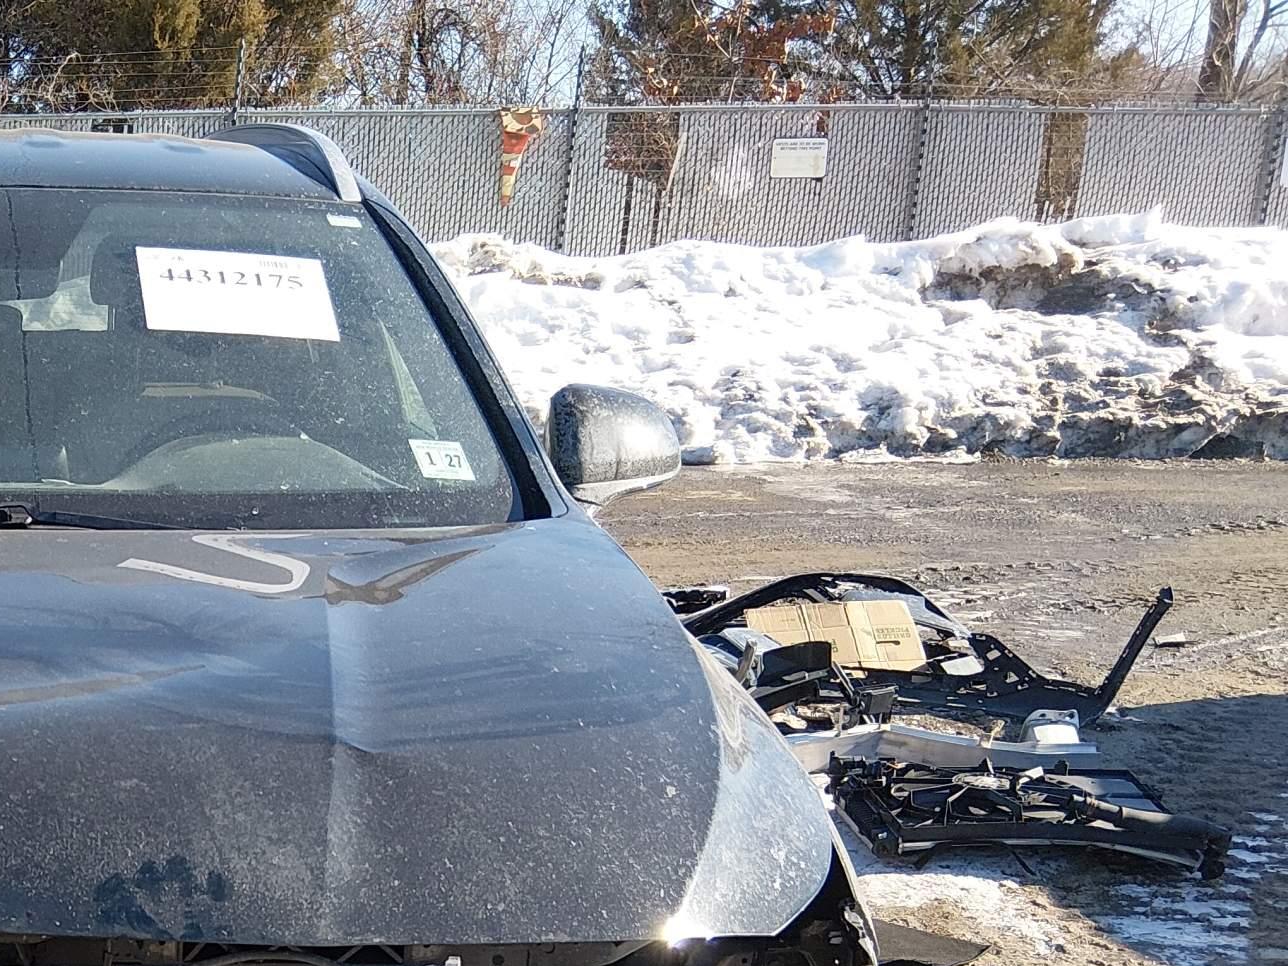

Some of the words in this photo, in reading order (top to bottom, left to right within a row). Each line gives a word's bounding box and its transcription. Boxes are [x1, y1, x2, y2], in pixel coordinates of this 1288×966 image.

[159, 267, 304, 290] 44312175
[425, 451, 438, 466] 1
[444, 453, 462, 469] 27
